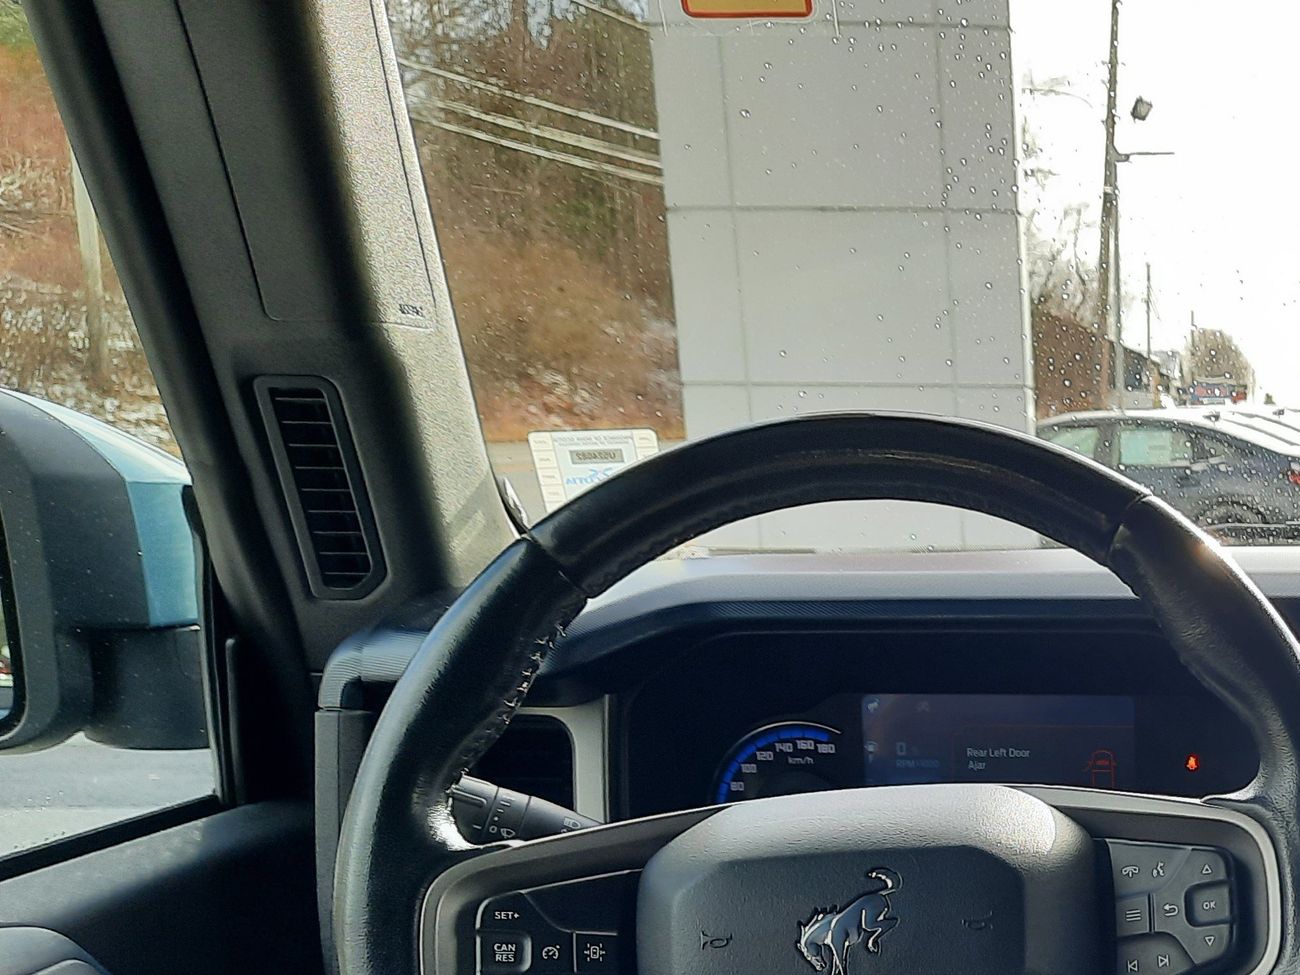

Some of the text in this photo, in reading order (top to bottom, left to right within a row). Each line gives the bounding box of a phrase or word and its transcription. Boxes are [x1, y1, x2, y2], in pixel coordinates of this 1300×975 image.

[774, 742, 793, 752] 140
[796, 740, 815, 750] 160
[816, 743, 836, 754] 180
[756, 751, 774, 761] 120
[966, 747, 1031, 758] Rear Left Door
[788, 756, 814, 765] km/h
[967, 760, 986, 772] Ajar
[1202, 900, 1217, 910] OK
[494, 911, 520, 920] SET+
[493, 943, 516, 952] CAN
[495, 953, 515, 962] RES
